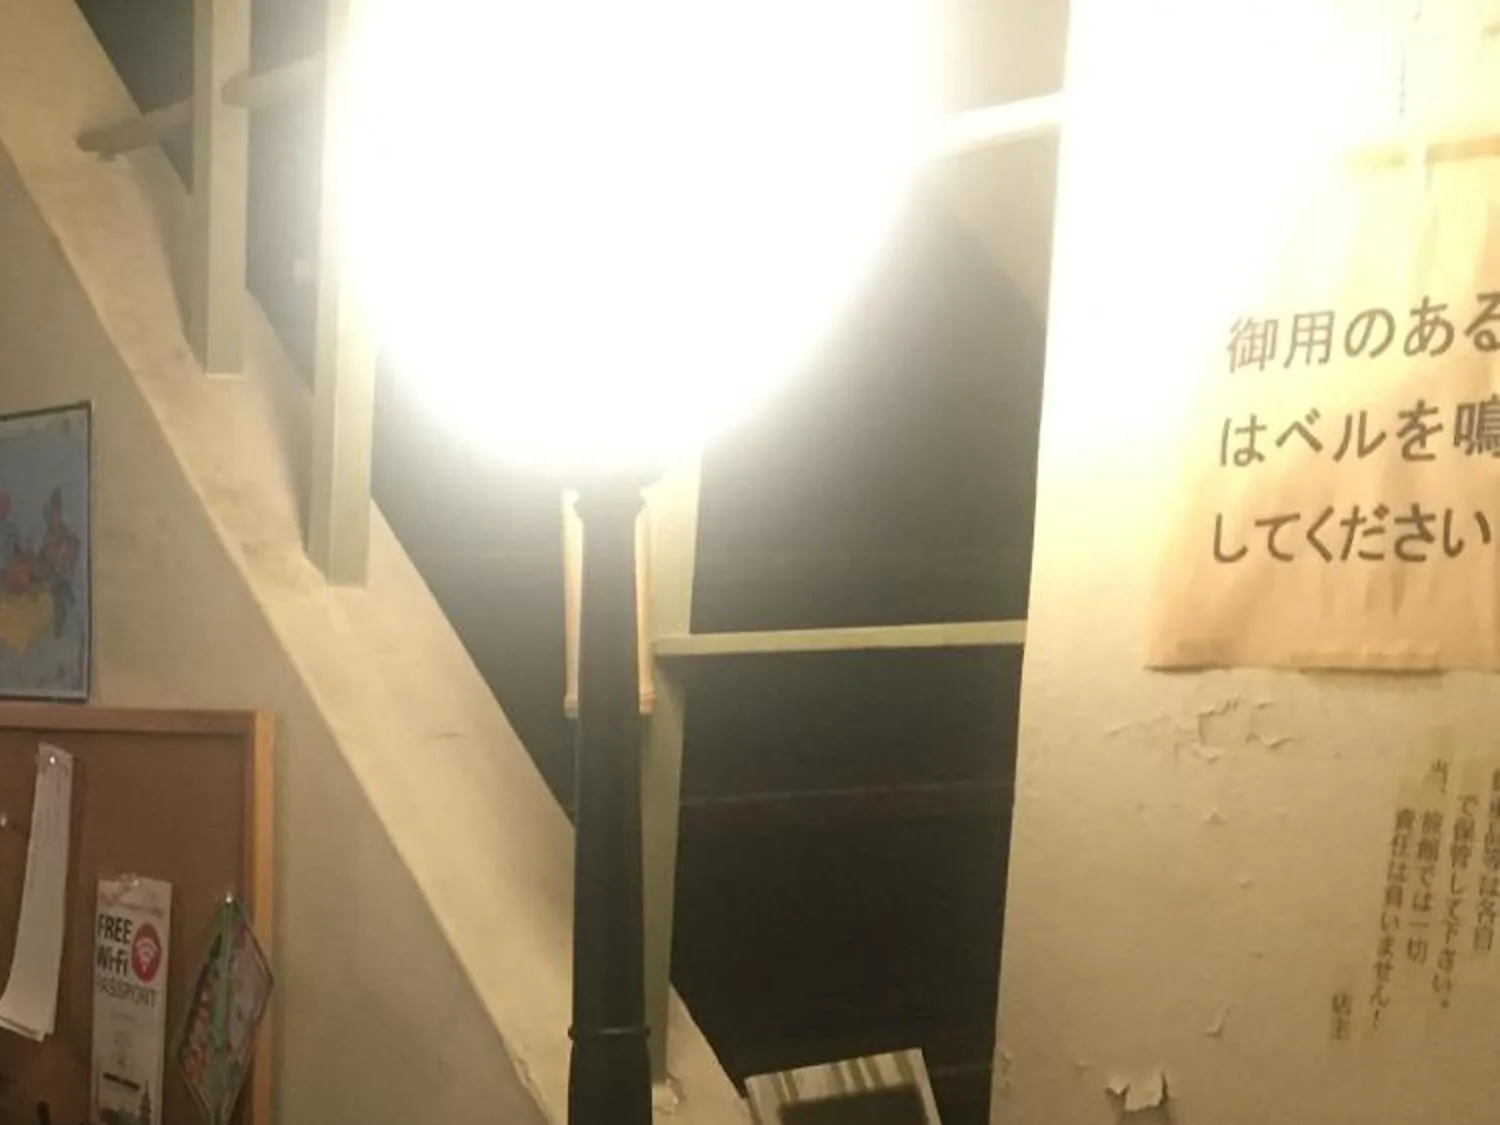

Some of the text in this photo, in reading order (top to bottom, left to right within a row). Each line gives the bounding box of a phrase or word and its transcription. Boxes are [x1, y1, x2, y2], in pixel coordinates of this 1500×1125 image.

[1226, 292, 1500, 373] 御用のある
[1220, 393, 1500, 467] はベルを鳴
[1213, 503, 1492, 563] してください
[98, 914, 133, 944] FREE
